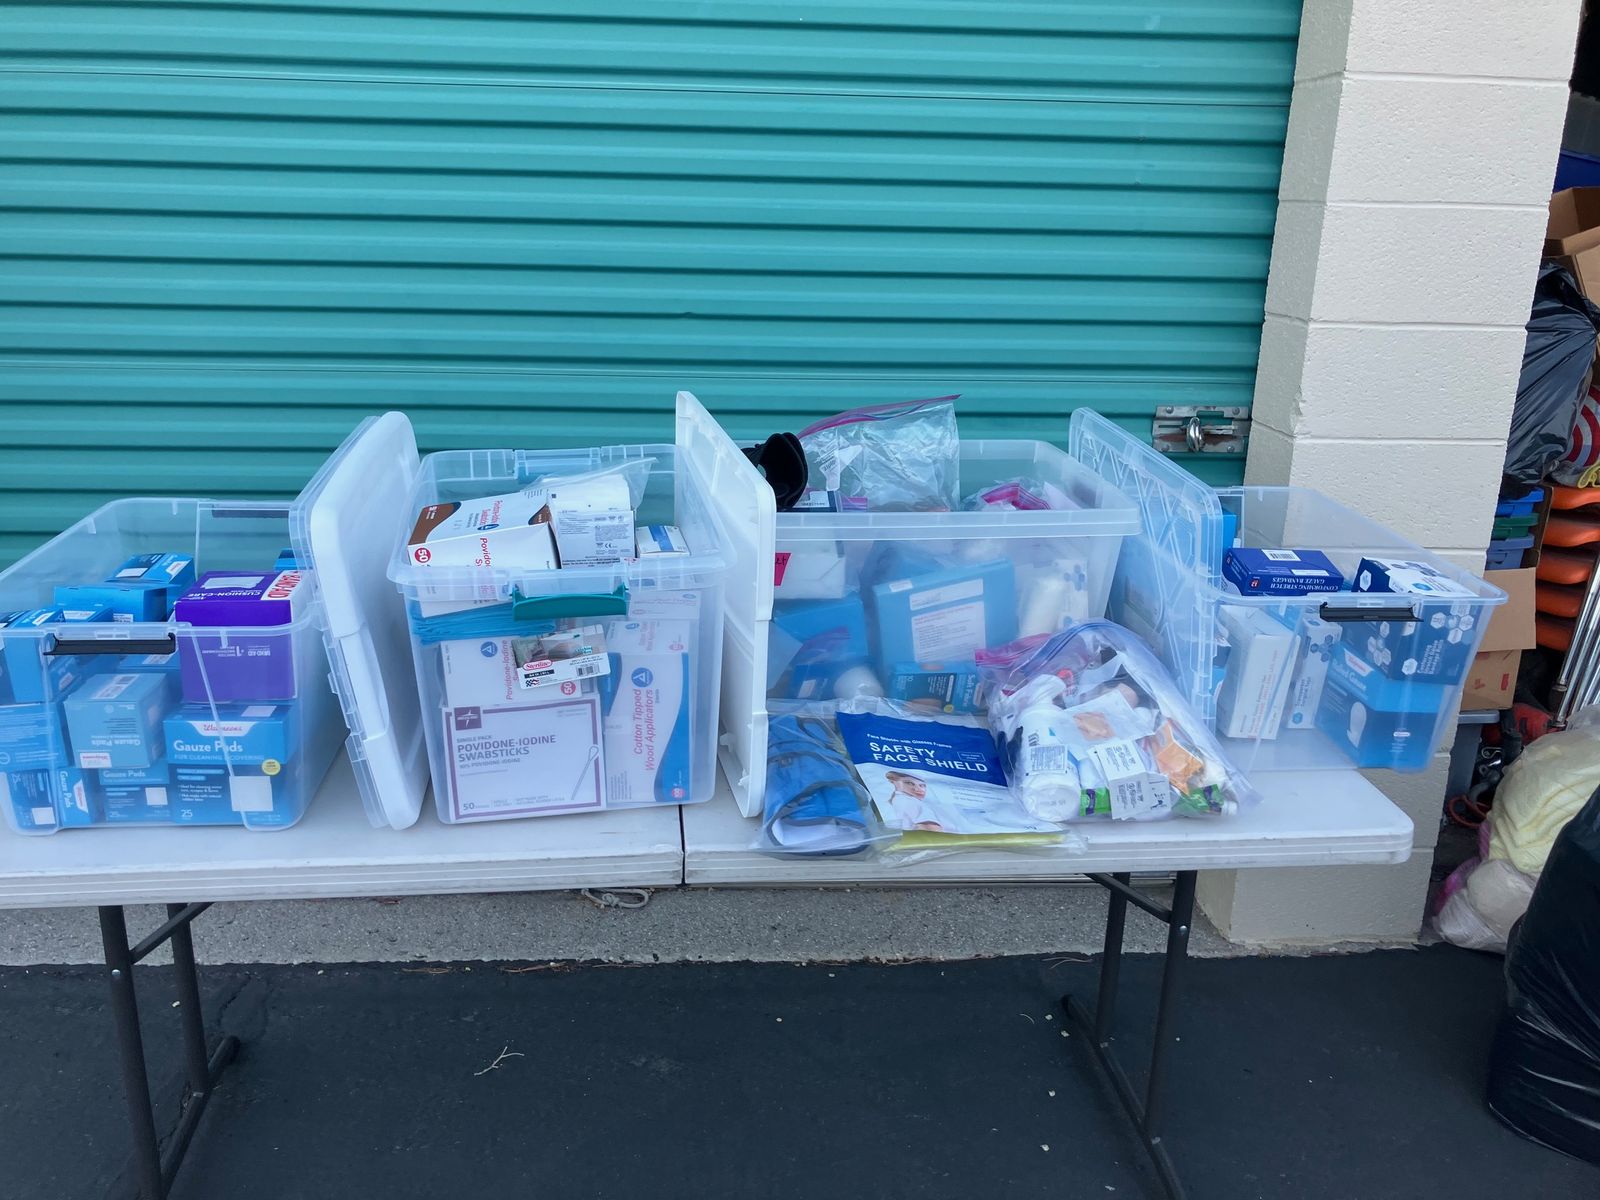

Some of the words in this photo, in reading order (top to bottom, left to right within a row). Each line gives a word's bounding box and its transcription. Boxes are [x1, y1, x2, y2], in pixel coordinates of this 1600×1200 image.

[417, 549, 429, 562] 50
[633, 689, 645, 721] Tipped
[644, 689, 656, 743] Applicators
[173, 740, 211, 752] Gauze
[215, 741, 244, 752] Pds
[458, 734, 557, 753] POVIDONE-IODINE
[634, 724, 643, 754] Cotton
[458, 746, 530, 763] SWABSTICKS
[645, 744, 655, 771] Wood
[869, 742, 936, 758] SAFETY
[873, 753, 921, 763] FACE
[925, 757, 988, 773] SHIELD
[463, 802, 475, 811] 50
